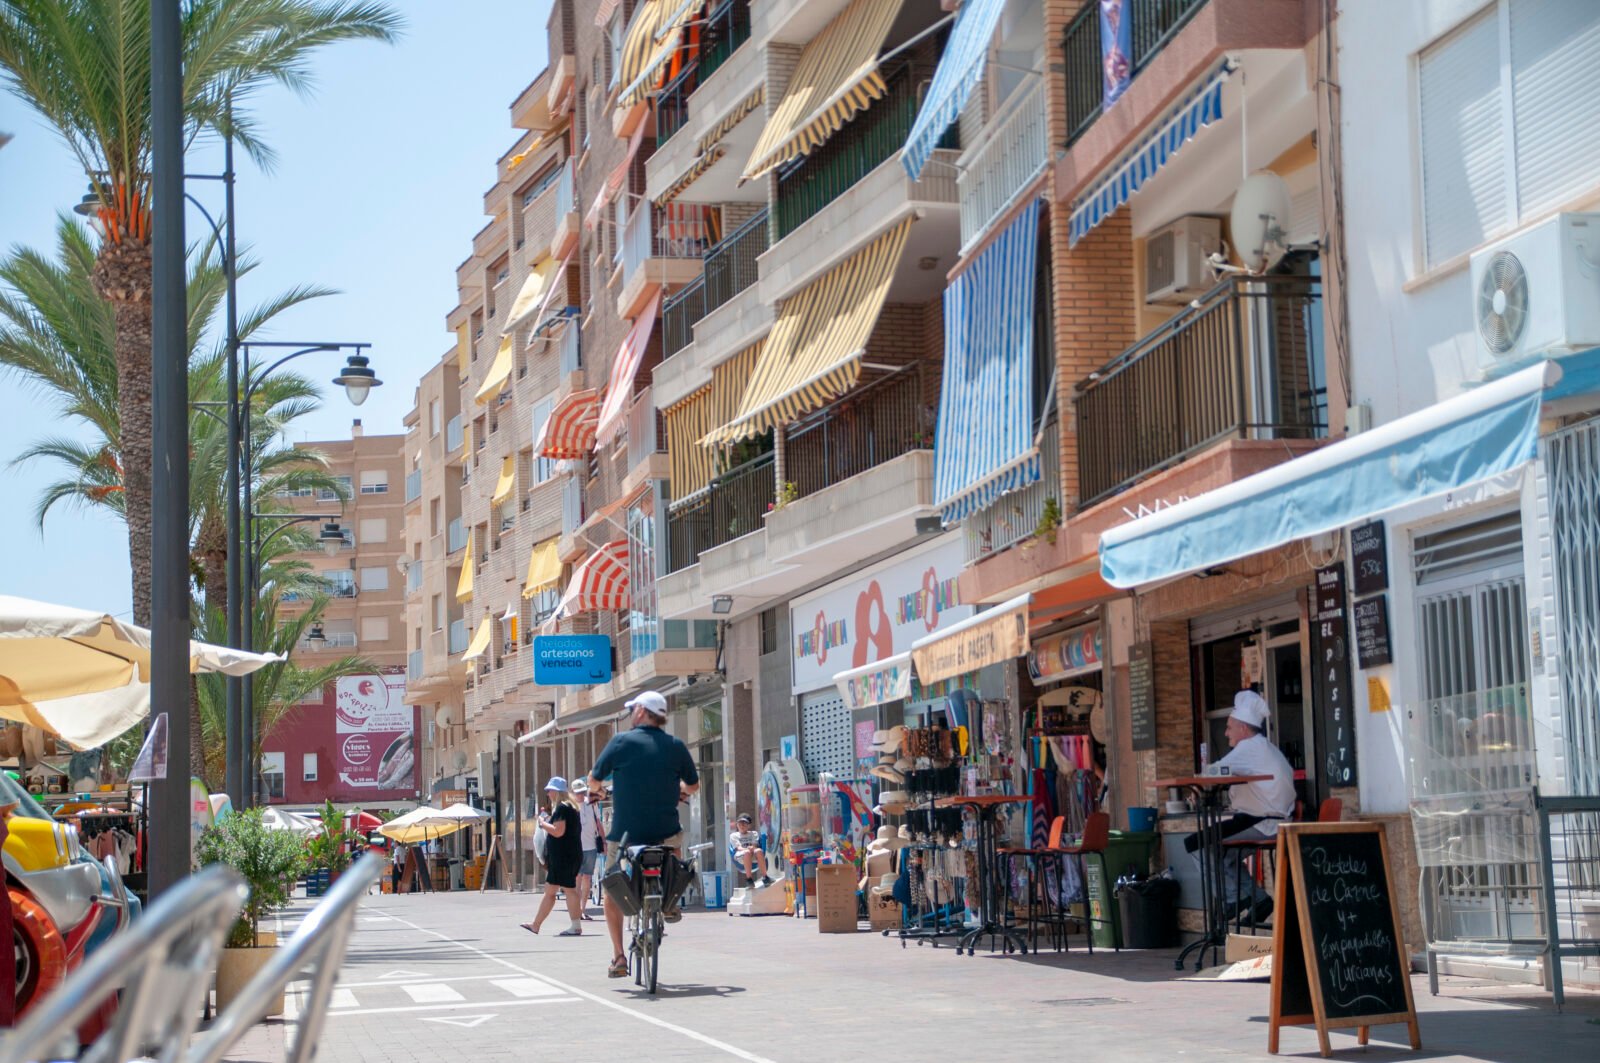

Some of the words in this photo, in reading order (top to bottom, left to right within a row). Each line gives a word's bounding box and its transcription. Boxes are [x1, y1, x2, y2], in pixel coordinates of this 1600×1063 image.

[1321, 622, 1333, 638] EL
[540, 648, 595, 658] artesanos
[540, 658, 583, 668] venecia
[1325, 648, 1350, 782] PASEITO
[1310, 847, 1367, 875] Pasteles
[1311, 882, 1331, 905] de
[1333, 877, 1381, 903] Carne
